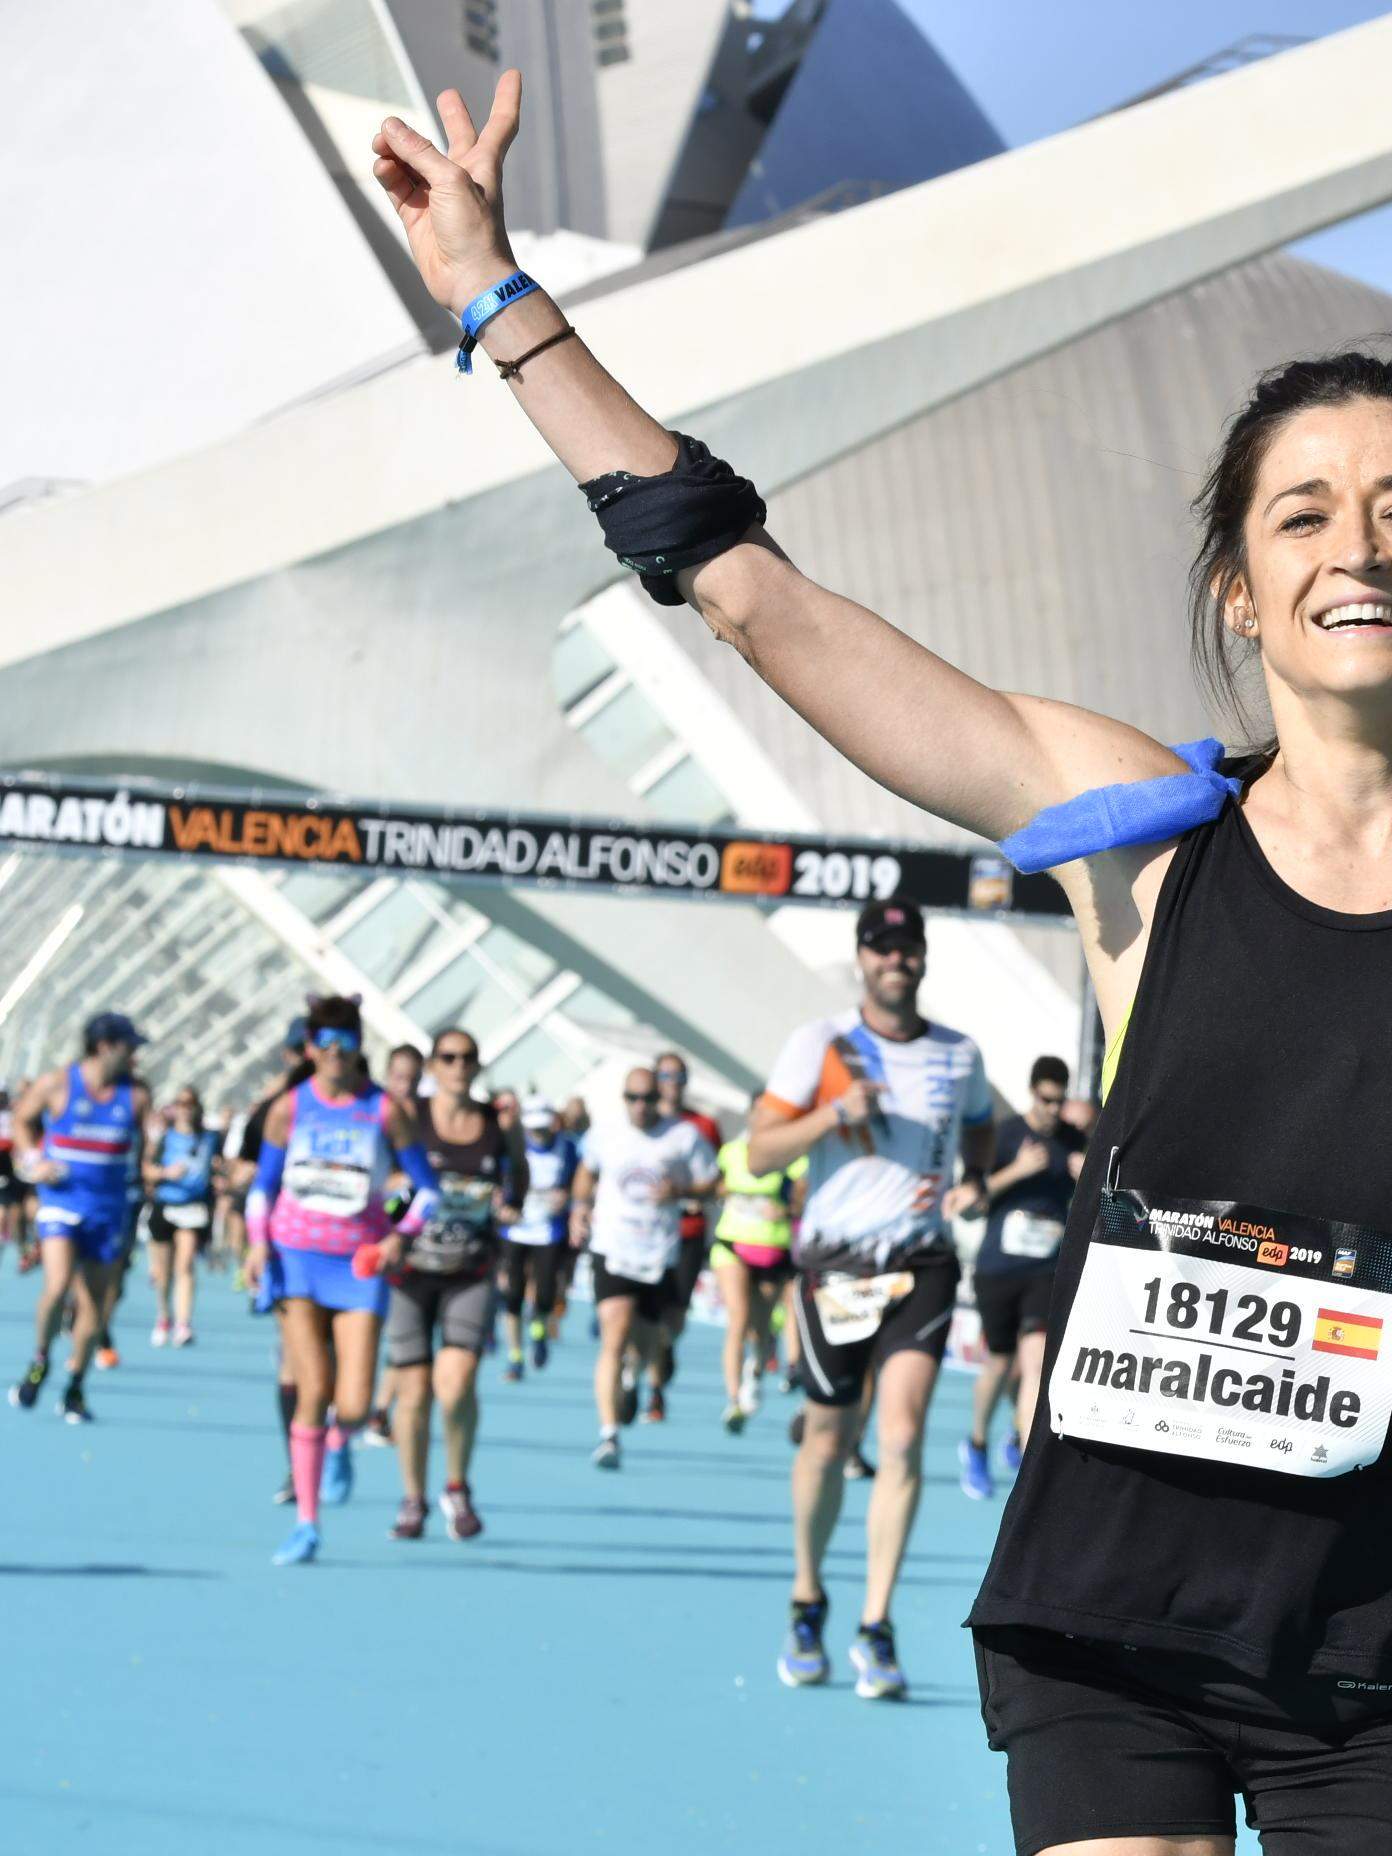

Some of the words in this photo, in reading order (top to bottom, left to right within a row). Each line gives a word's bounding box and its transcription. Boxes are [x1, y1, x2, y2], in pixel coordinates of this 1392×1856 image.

[0, 792, 165, 848] ARATÓN
[169, 806, 361, 861] VALENCIA
[359, 819, 537, 873] TRINIDAD
[537, 836, 720, 888] ALFONSO
[794, 851, 901, 898] 2019
[1149, 1208, 1215, 1229] MARATÓN
[1217, 1218, 1276, 1241] VALENCIA
[1149, 1221, 1201, 1240] TRINIDAD
[1203, 1232, 1258, 1252] ALFONSO
[1262, 1246, 1284, 1261] edp
[1289, 1247, 1322, 1264] 2019
[1143, 1277, 1302, 1348] 18129
[1071, 1346, 1362, 1428] maralcaide
[1216, 1435, 1251, 1448] Esfuerzo
[1270, 1437, 1293, 1455] edp
